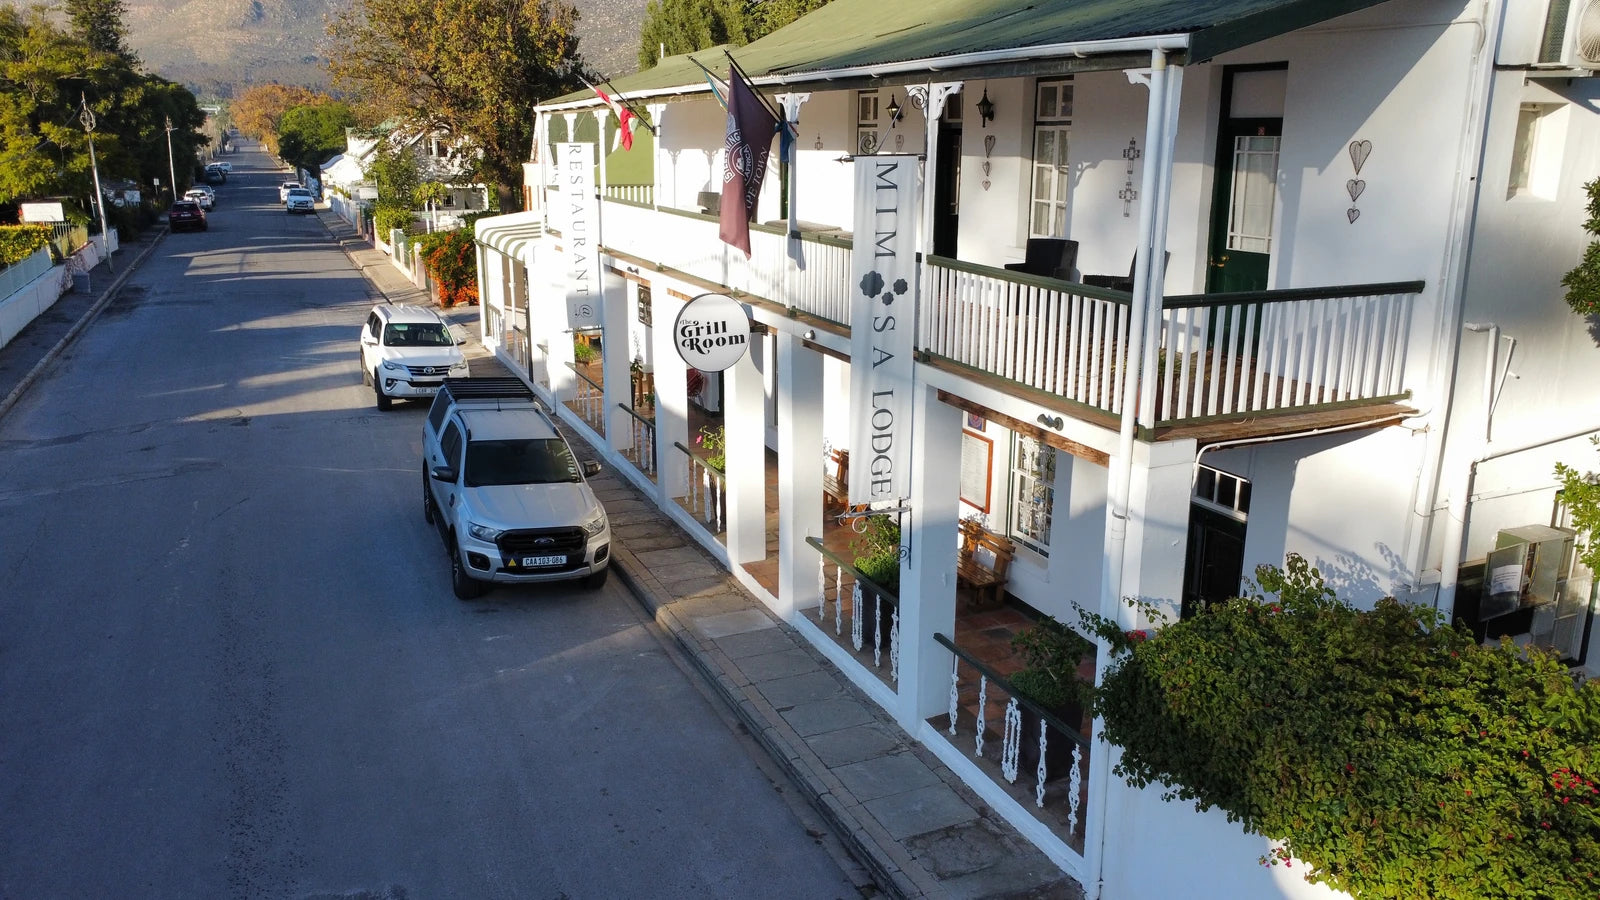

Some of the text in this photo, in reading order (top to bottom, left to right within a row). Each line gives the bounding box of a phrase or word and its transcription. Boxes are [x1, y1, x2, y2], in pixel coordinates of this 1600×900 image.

[744, 147, 752, 178] AFRICA
[753, 147, 768, 184] TOWN
[568, 144, 589, 296] RESTAURANT
[681, 320, 728, 338] Grill
[681, 334, 746, 355] Room
[870, 388, 894, 497] LODGE
[525, 558, 538, 566] CAA
